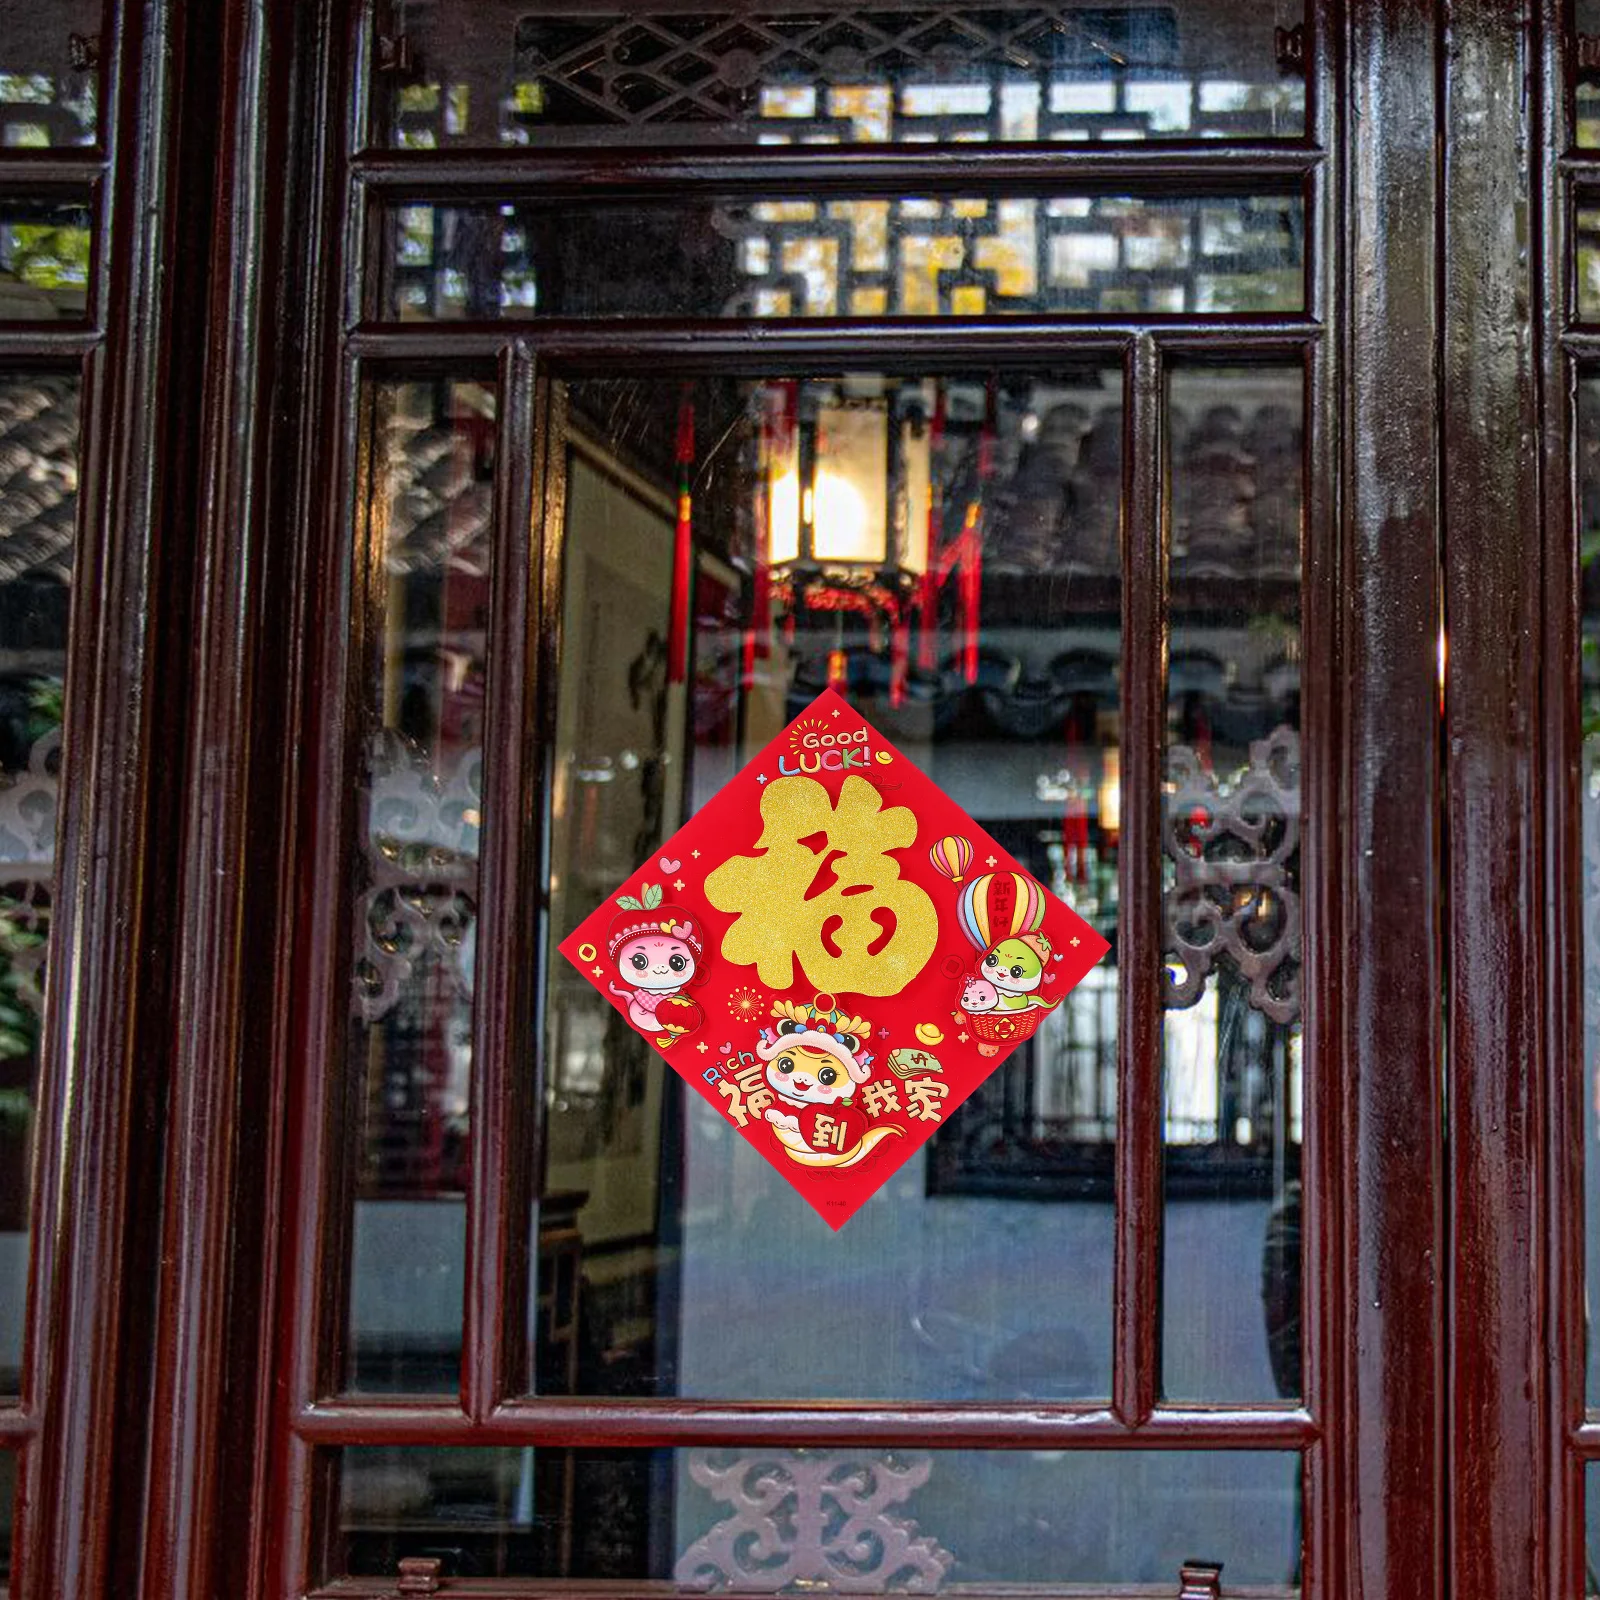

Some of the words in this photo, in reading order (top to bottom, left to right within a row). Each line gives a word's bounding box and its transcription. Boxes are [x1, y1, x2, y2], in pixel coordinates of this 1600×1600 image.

[802, 726, 869, 749] Good
[778, 745, 872, 776] LUCK!
[703, 774, 939, 998] 福
[993, 880, 1011, 928] 新年好
[702, 1050, 755, 1086] Rich
